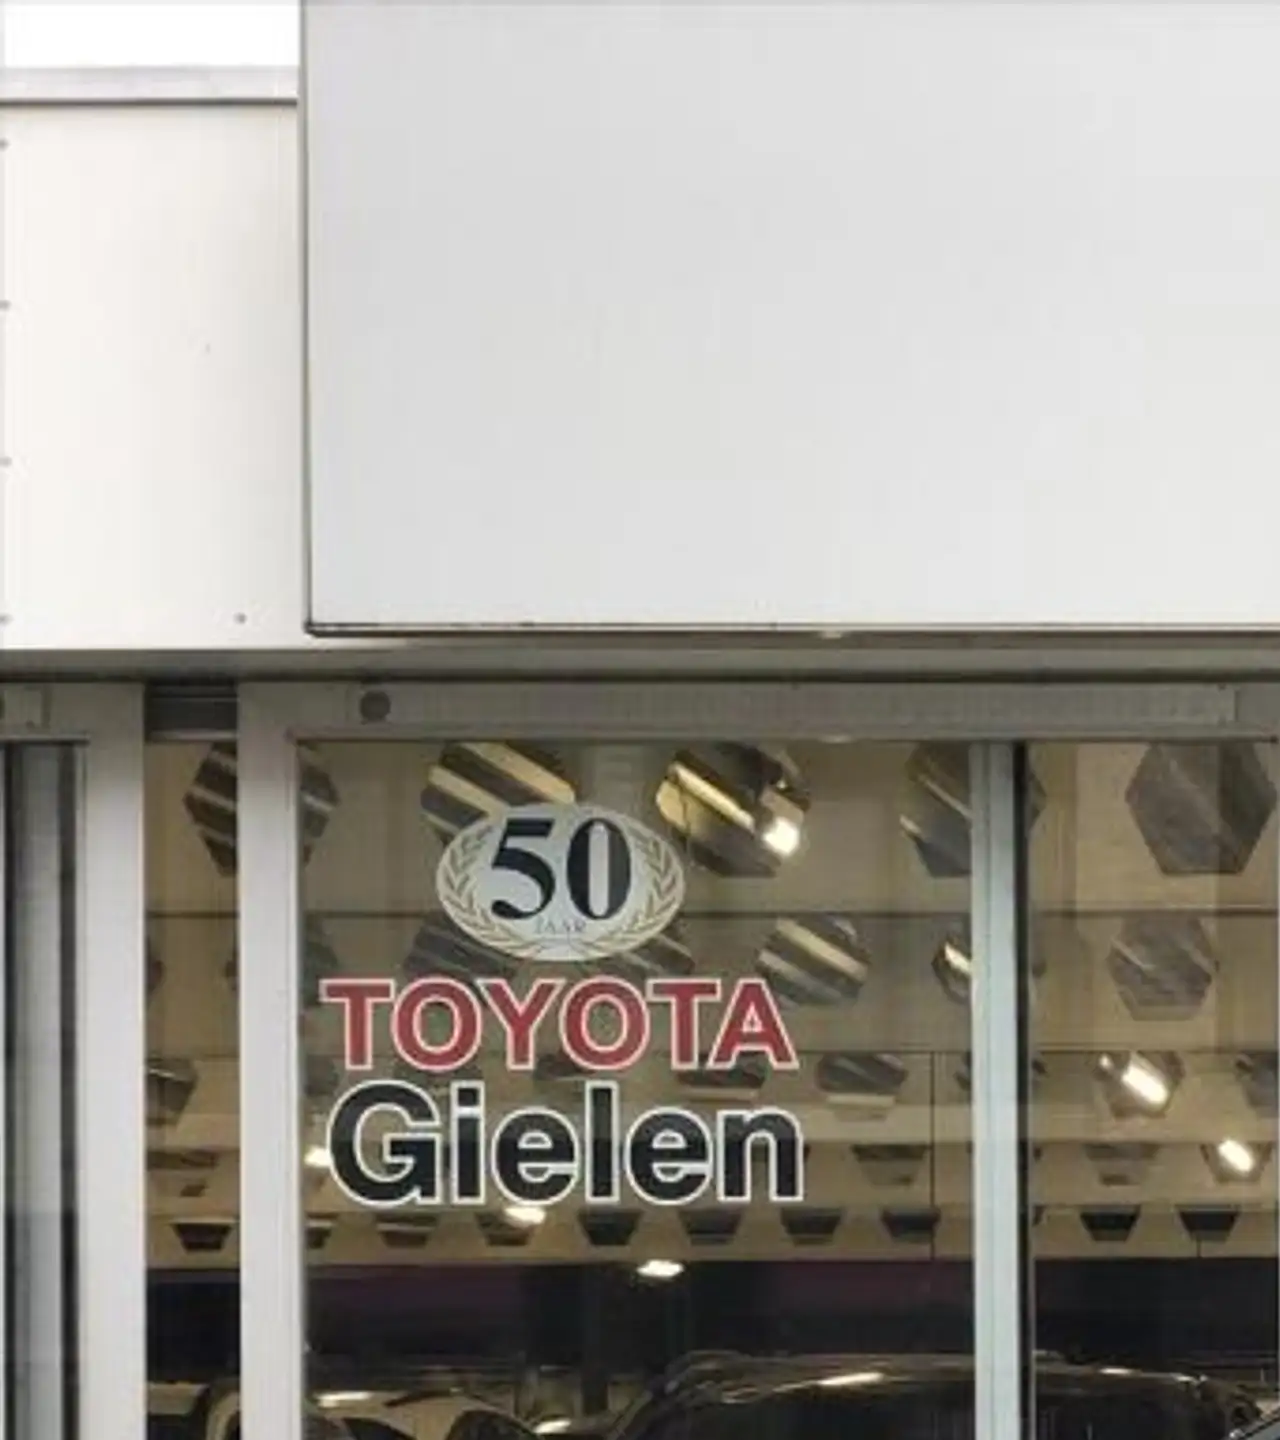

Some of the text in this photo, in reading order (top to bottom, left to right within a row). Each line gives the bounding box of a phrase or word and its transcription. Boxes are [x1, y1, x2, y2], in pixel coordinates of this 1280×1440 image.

[490, 818, 632, 920] 50
[319, 976, 799, 1071] TOYOTA
[327, 1080, 804, 1204] Gielen
